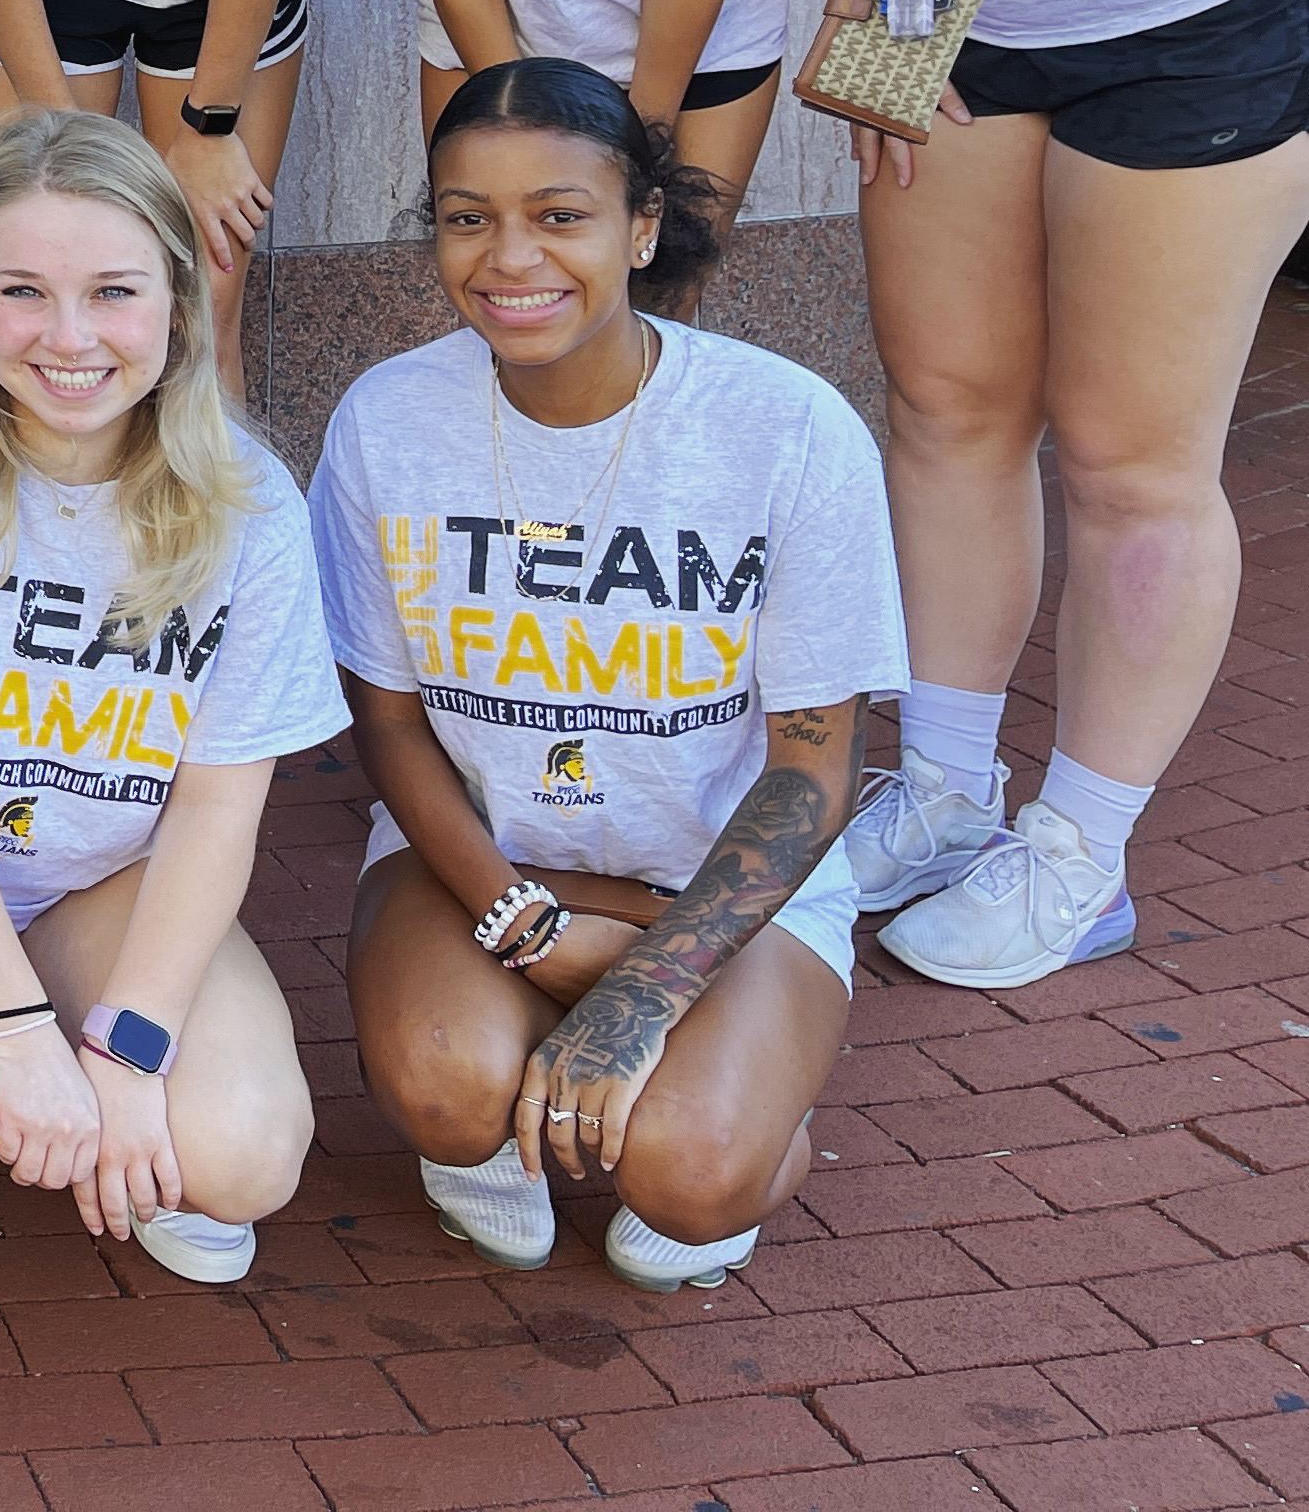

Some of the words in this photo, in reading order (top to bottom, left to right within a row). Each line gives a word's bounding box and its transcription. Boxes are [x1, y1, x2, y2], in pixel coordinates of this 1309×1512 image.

[446, 516, 767, 614] TEAM
[449, 605, 753, 701] FAMILY
[512, 703, 557, 729] TECH
[563, 708, 673, 735] COMMUNITY
[677, 696, 743, 732] COLLEGE
[25, 761, 126, 800] COMMUNITY
[531, 791, 606, 807] TROJANS
